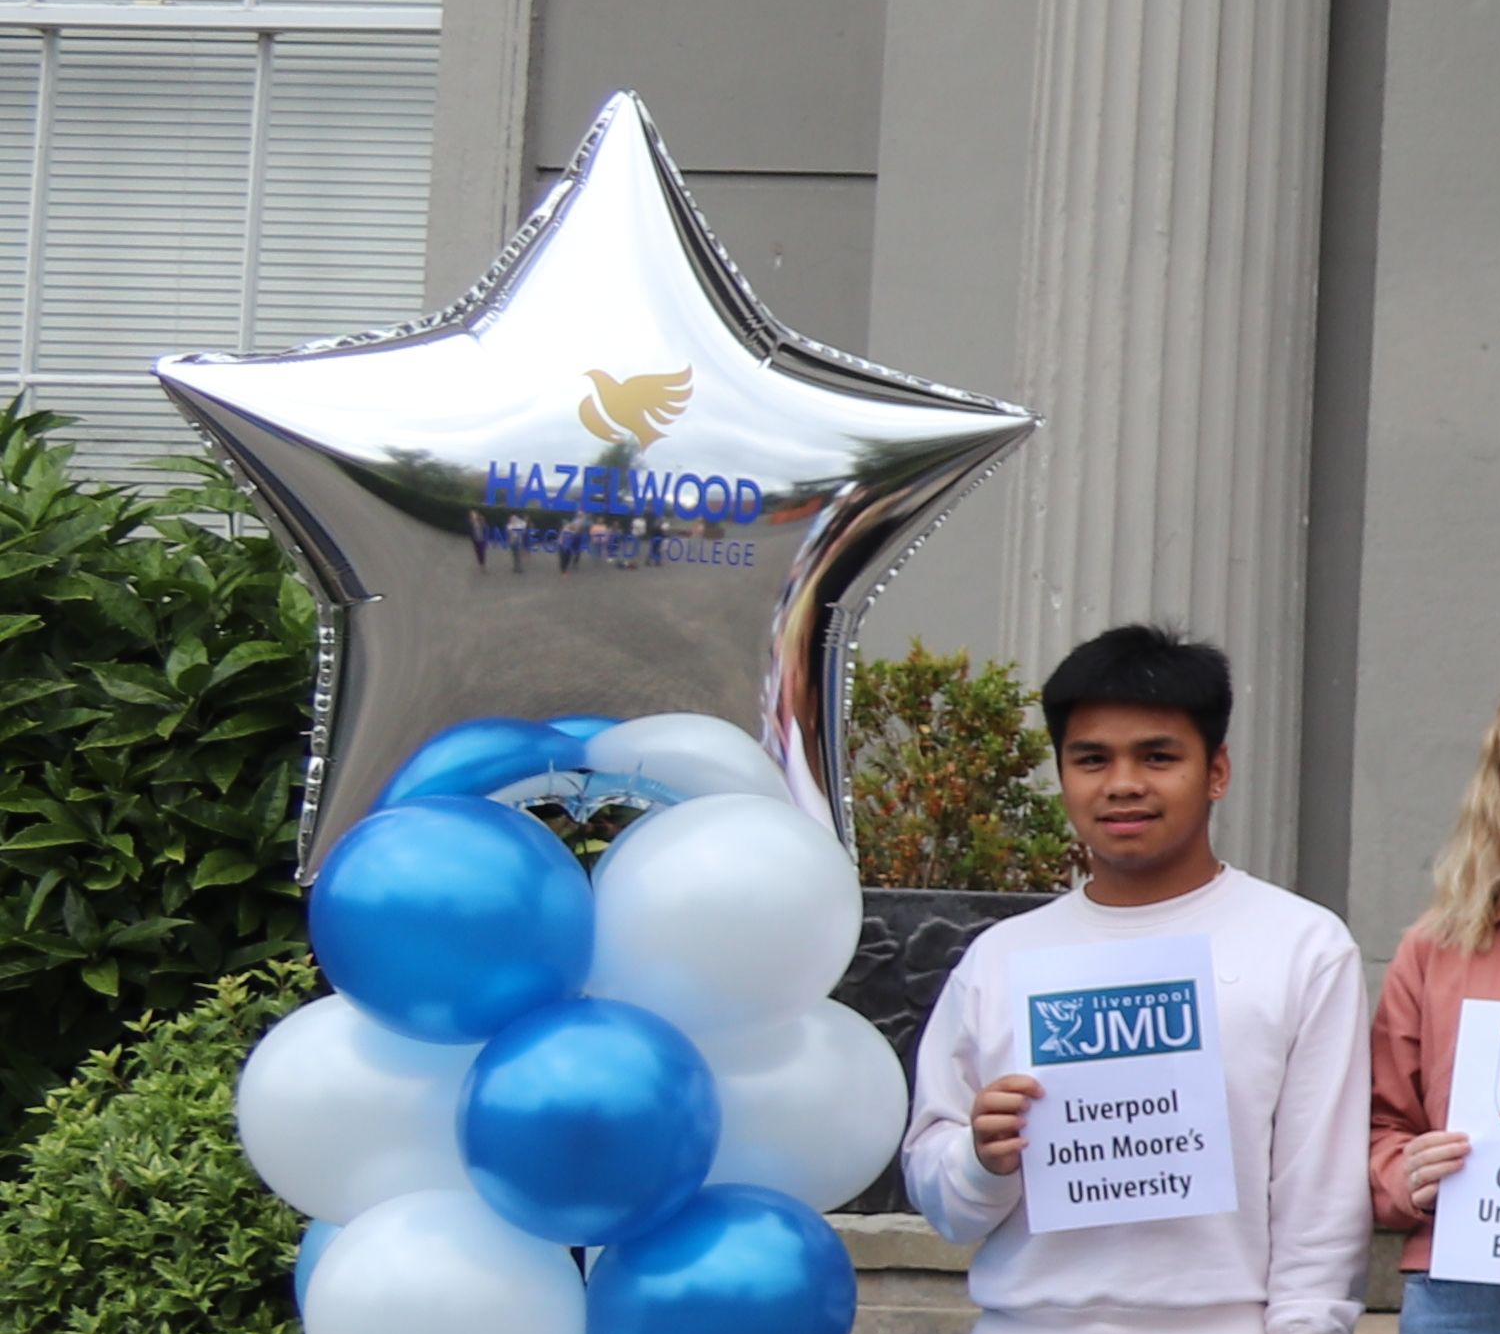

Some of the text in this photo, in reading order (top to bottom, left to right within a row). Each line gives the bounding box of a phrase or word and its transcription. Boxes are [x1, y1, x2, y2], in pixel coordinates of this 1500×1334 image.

[485, 461, 763, 524] HAZELWOOD
[650, 533, 755, 567] COLLEGE
[1093, 988, 1191, 1009] liverpool
[1080, 1003, 1194, 1054] JMU
[1065, 1089, 1179, 1123] Liverpool
[1047, 1128, 1205, 1167] John Moore's
[1068, 1171, 1192, 1204] University
